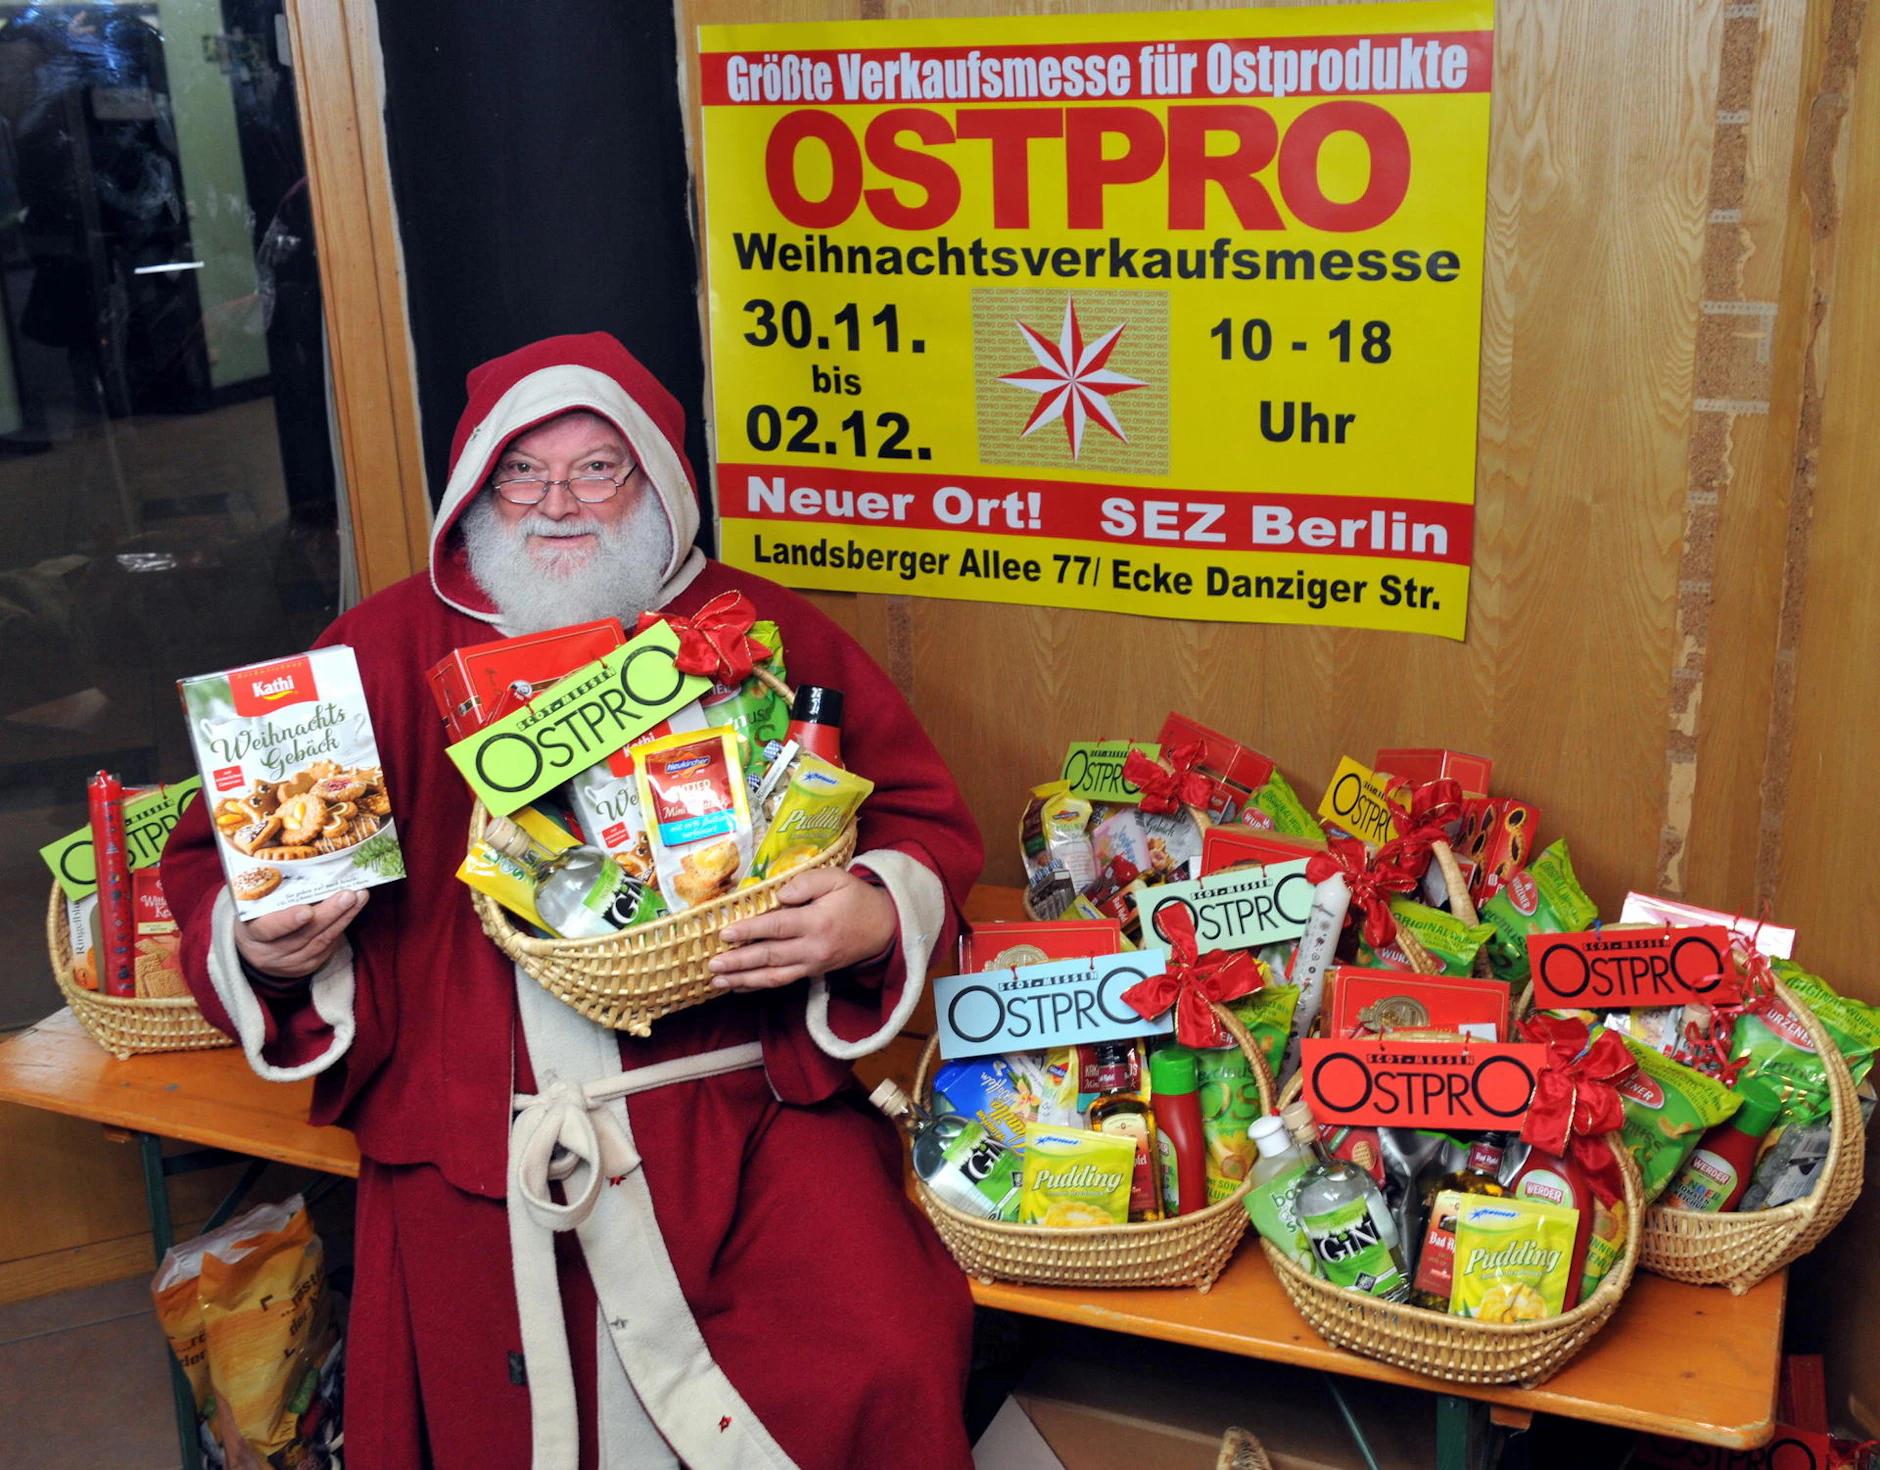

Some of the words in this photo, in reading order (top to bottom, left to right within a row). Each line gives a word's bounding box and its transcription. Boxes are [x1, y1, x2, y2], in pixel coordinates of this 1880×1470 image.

[726, 52, 833, 103] Größte
[841, 47, 1129, 101] Verkaufsmesse
[1138, 44, 1200, 95] für
[1206, 38, 1468, 97] Ostprodukte
[764, 100, 1411, 233] OSTPRO
[732, 231, 1461, 284] Weihnachtsverkaufsmesse
[742, 299, 927, 355] 30.11.
[1209, 318, 1272, 363] 10
[1328, 320, 1393, 364] 18
[811, 364, 863, 397] bis
[746, 405, 933, 461] 02.12.
[1258, 400, 1357, 446] Uhr
[747, 476, 915, 522] Neuer
[931, 487, 1043, 531] Ort!
[1100, 496, 1227, 545] SEZ
[1252, 505, 1449, 556] Berlin
[753, 534, 951, 582] Landsberger
[958, 546, 1043, 585] Allee
[1111, 560, 1194, 597] Ecke
[1205, 565, 1368, 611] Danziger
[1379, 573, 1443, 611] Str.
[252, 675, 295, 698] Kathi
[515, 666, 618, 731] SCOT-MESSEN
[210, 702, 347, 762] Weihnachts
[475, 644, 686, 793] OSTPRO
[622, 731, 656, 759] Kthi
[260, 730, 340, 781] Gebäck
[1151, 873, 1309, 943] OSTPRO
[998, 970, 1099, 992] SCOT-MESSEN
[1540, 936, 1724, 998] OSTPRO
[948, 966, 1149, 1043] OSTPRO
[1311, 1051, 1535, 1118] OSTPRO
[1366, 1053, 1475, 1066] SCOT-MESSEN
[1031, 1164, 1124, 1194] Pudding
[1526, 1182, 1563, 1203] WERDER
[1692, 1156, 1730, 1185] WERDER
[1463, 1239, 1562, 1276] Pudding
